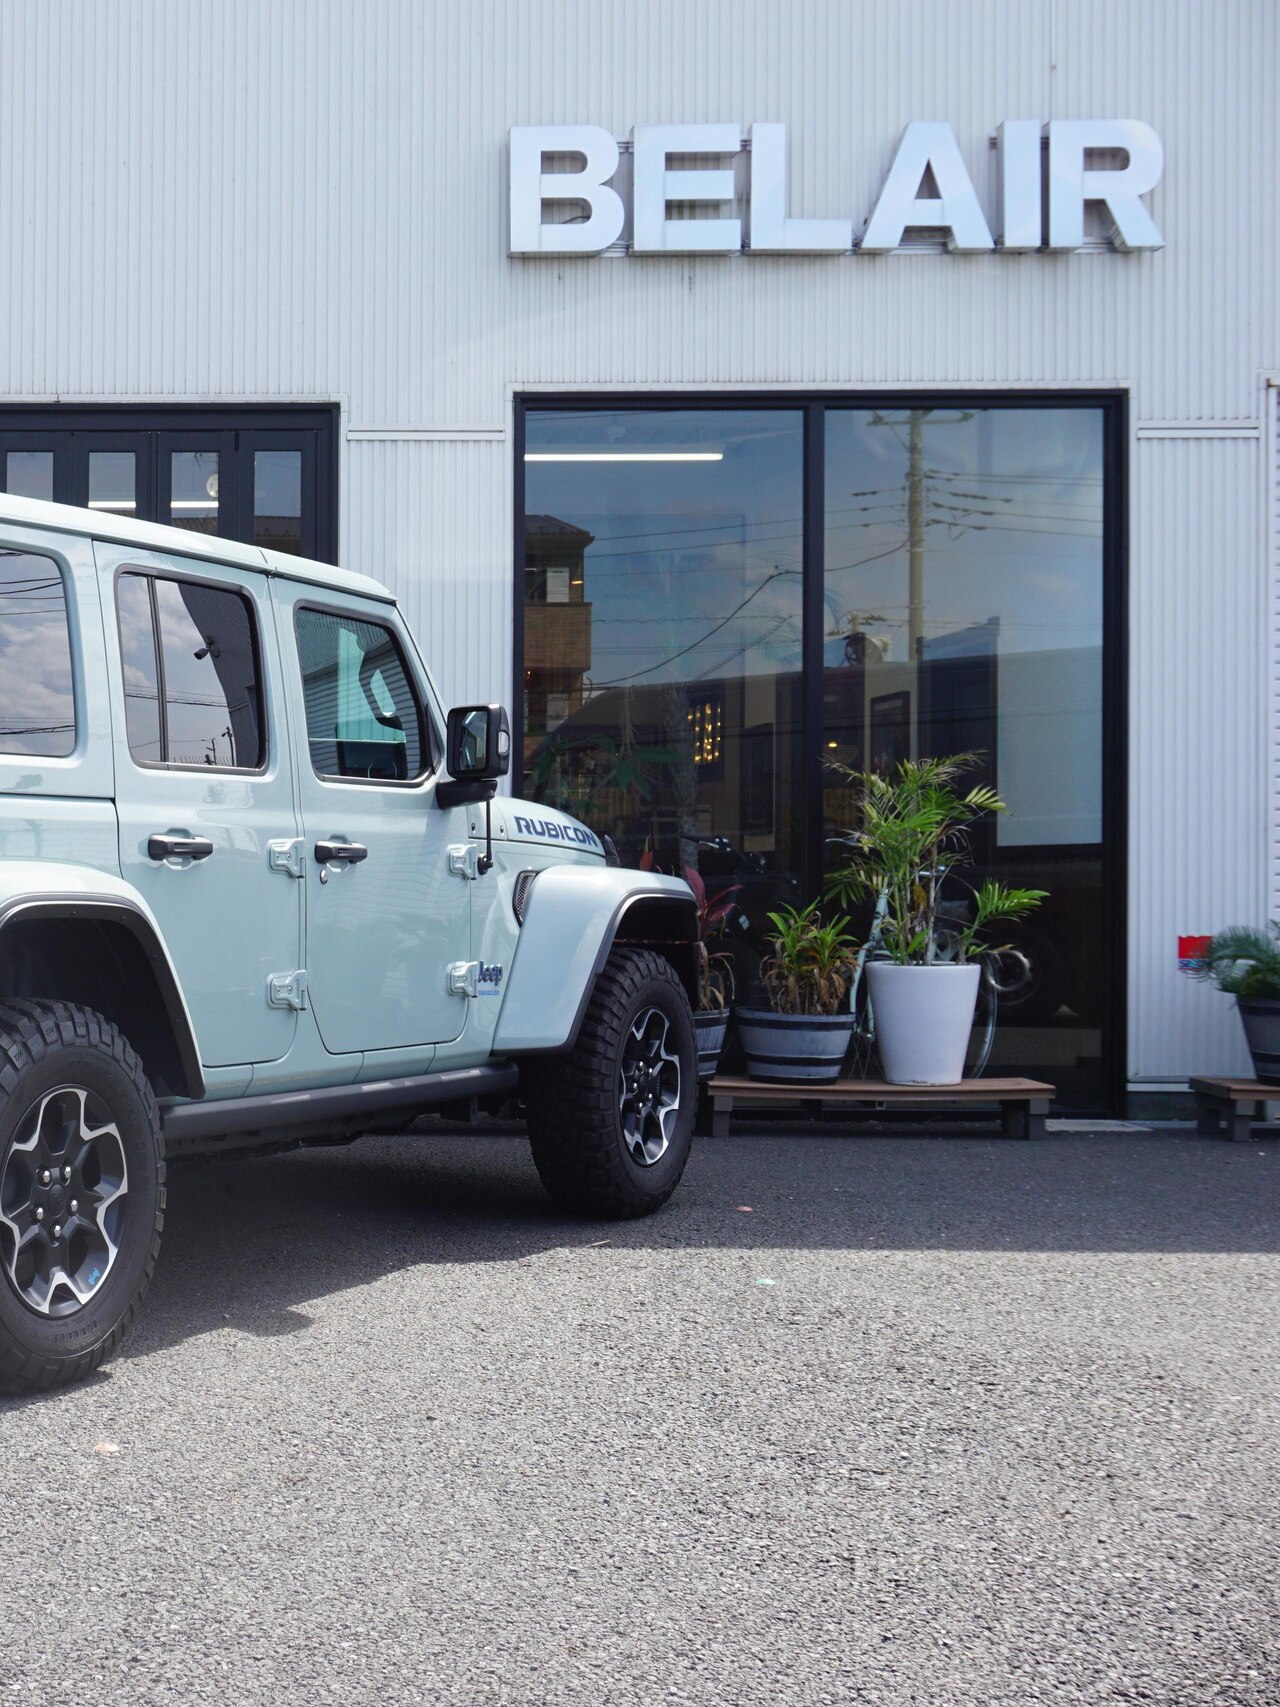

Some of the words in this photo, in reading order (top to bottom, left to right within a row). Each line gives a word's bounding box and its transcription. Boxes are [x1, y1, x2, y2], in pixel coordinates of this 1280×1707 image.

[508, 119, 1165, 258] BELAIR
[514, 816, 598, 848] RUBICON
[478, 960, 503, 986] Jeep
